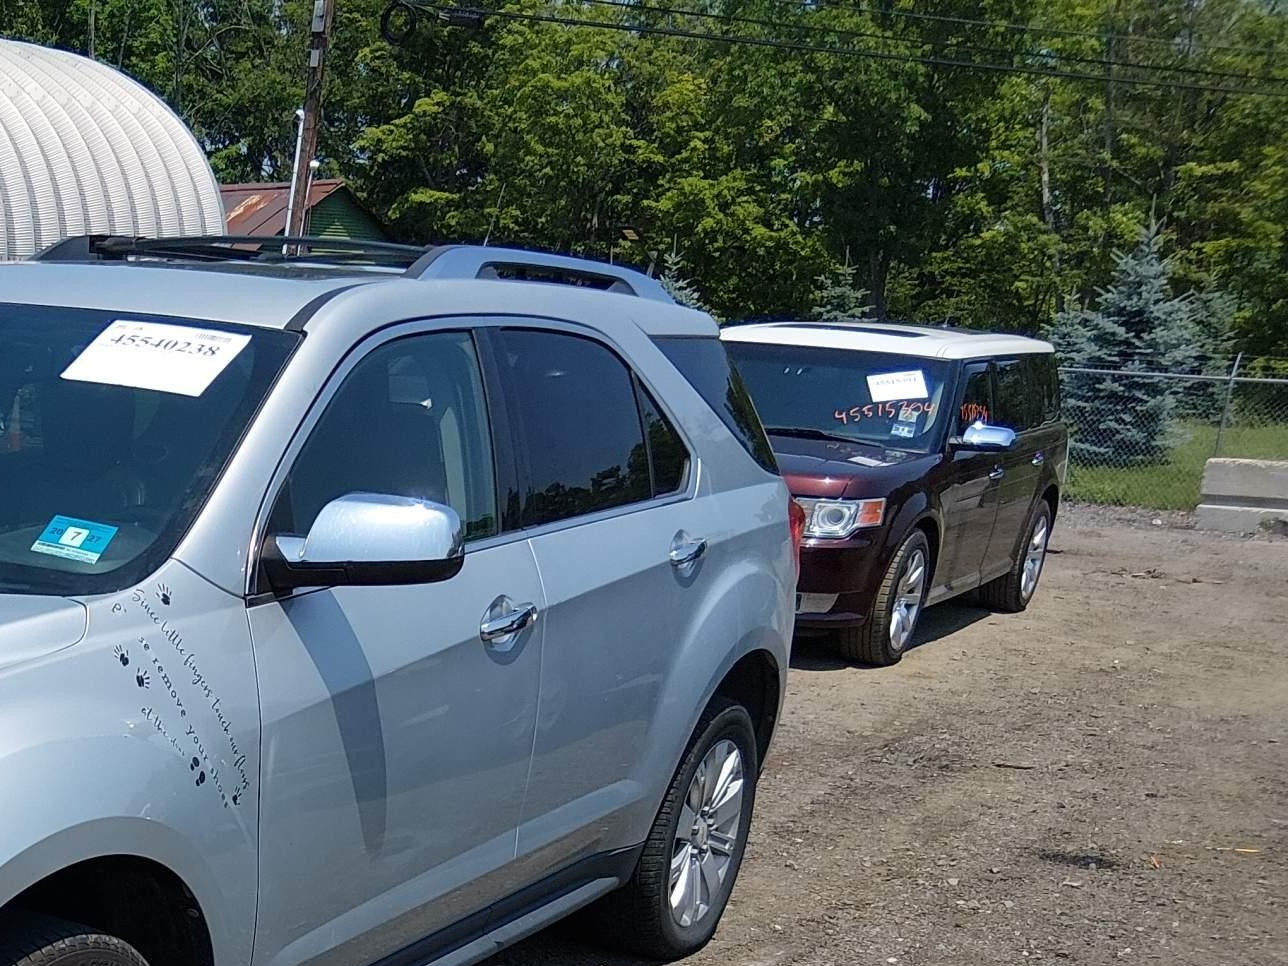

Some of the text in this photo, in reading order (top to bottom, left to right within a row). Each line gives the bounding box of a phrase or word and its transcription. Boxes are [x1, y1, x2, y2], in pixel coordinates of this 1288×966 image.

[110, 333, 220, 357] 45540238
[70, 531, 83, 542] 7
[183, 653, 213, 698] fingers
[152, 657, 186, 718] remove
[185, 724, 209, 761] your
